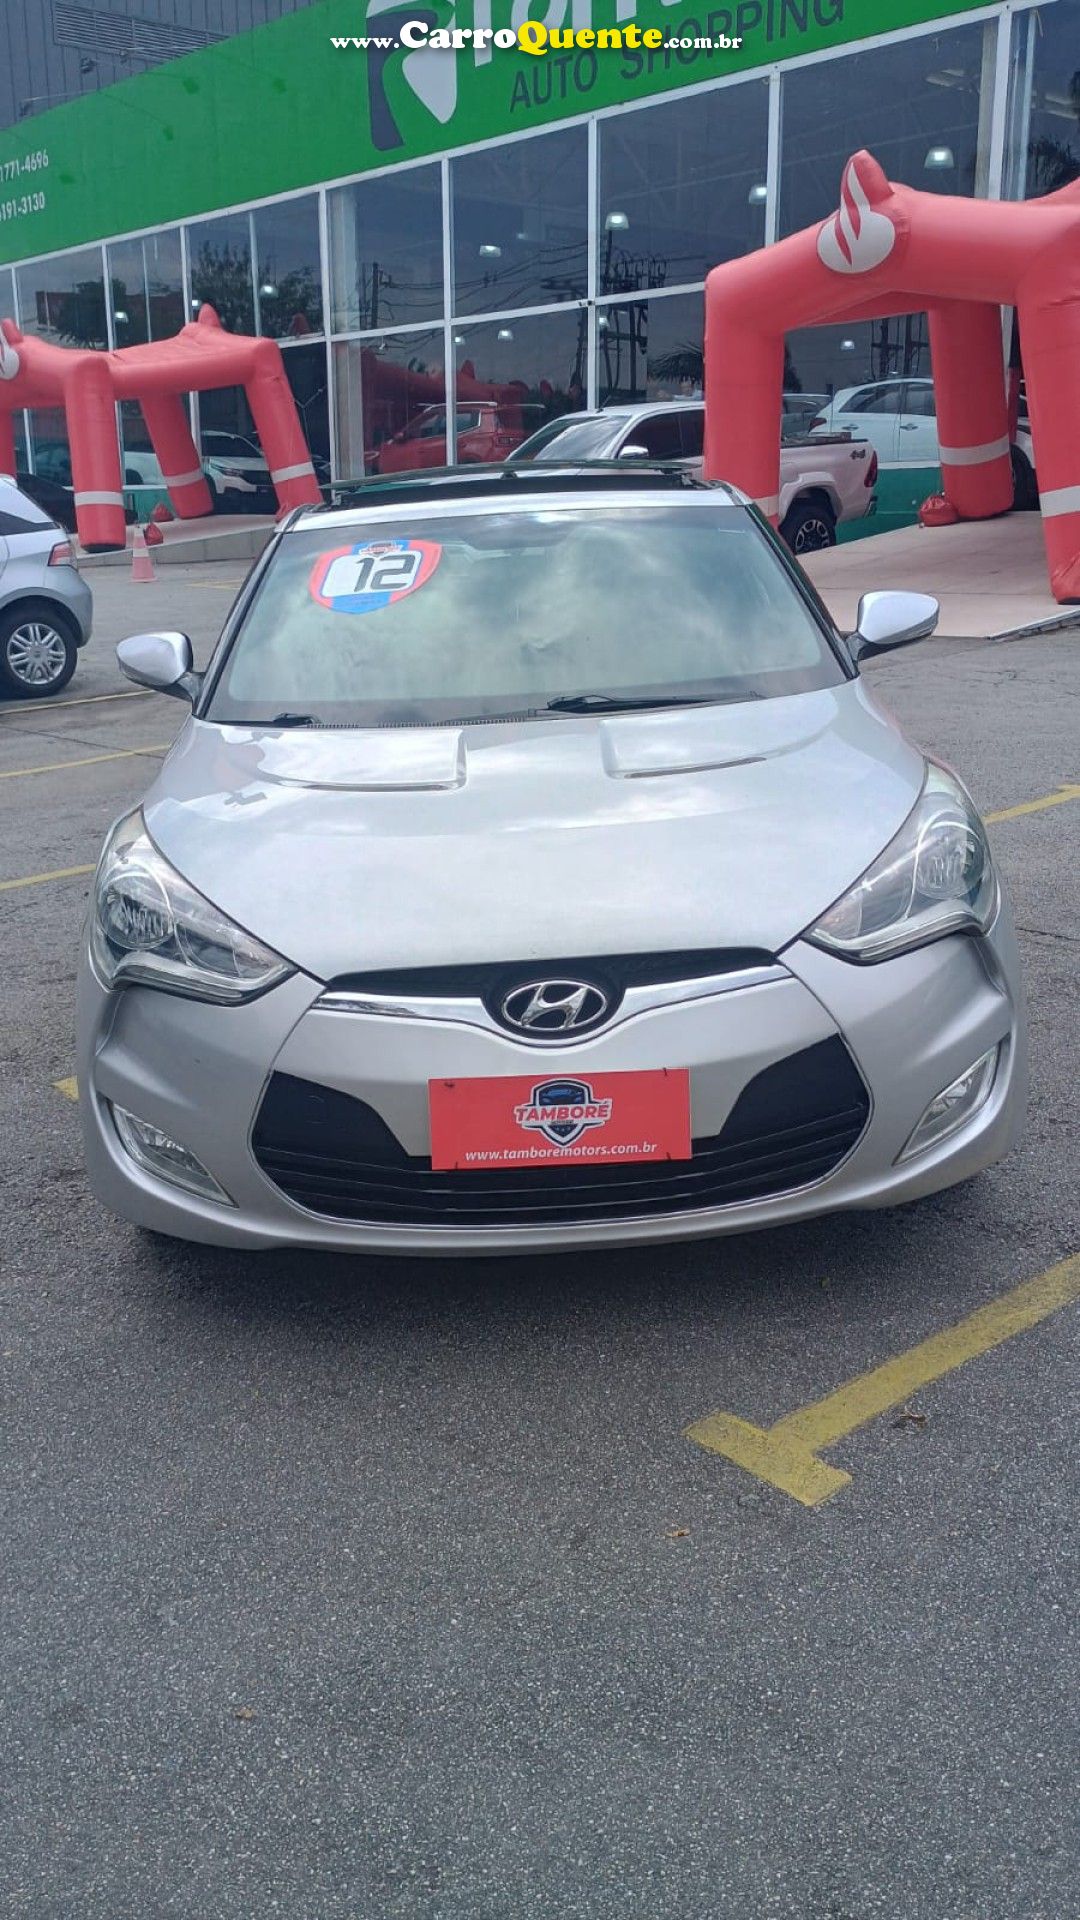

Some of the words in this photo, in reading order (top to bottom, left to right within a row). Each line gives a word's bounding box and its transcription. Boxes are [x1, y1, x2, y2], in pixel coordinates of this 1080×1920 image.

[509, 49, 599, 114] AUTO
[0, 191, 45, 221] 191-3130
[353, 554, 416, 593] 12
[464, 1141, 658, 1162] www.tamboremotors.com.br
